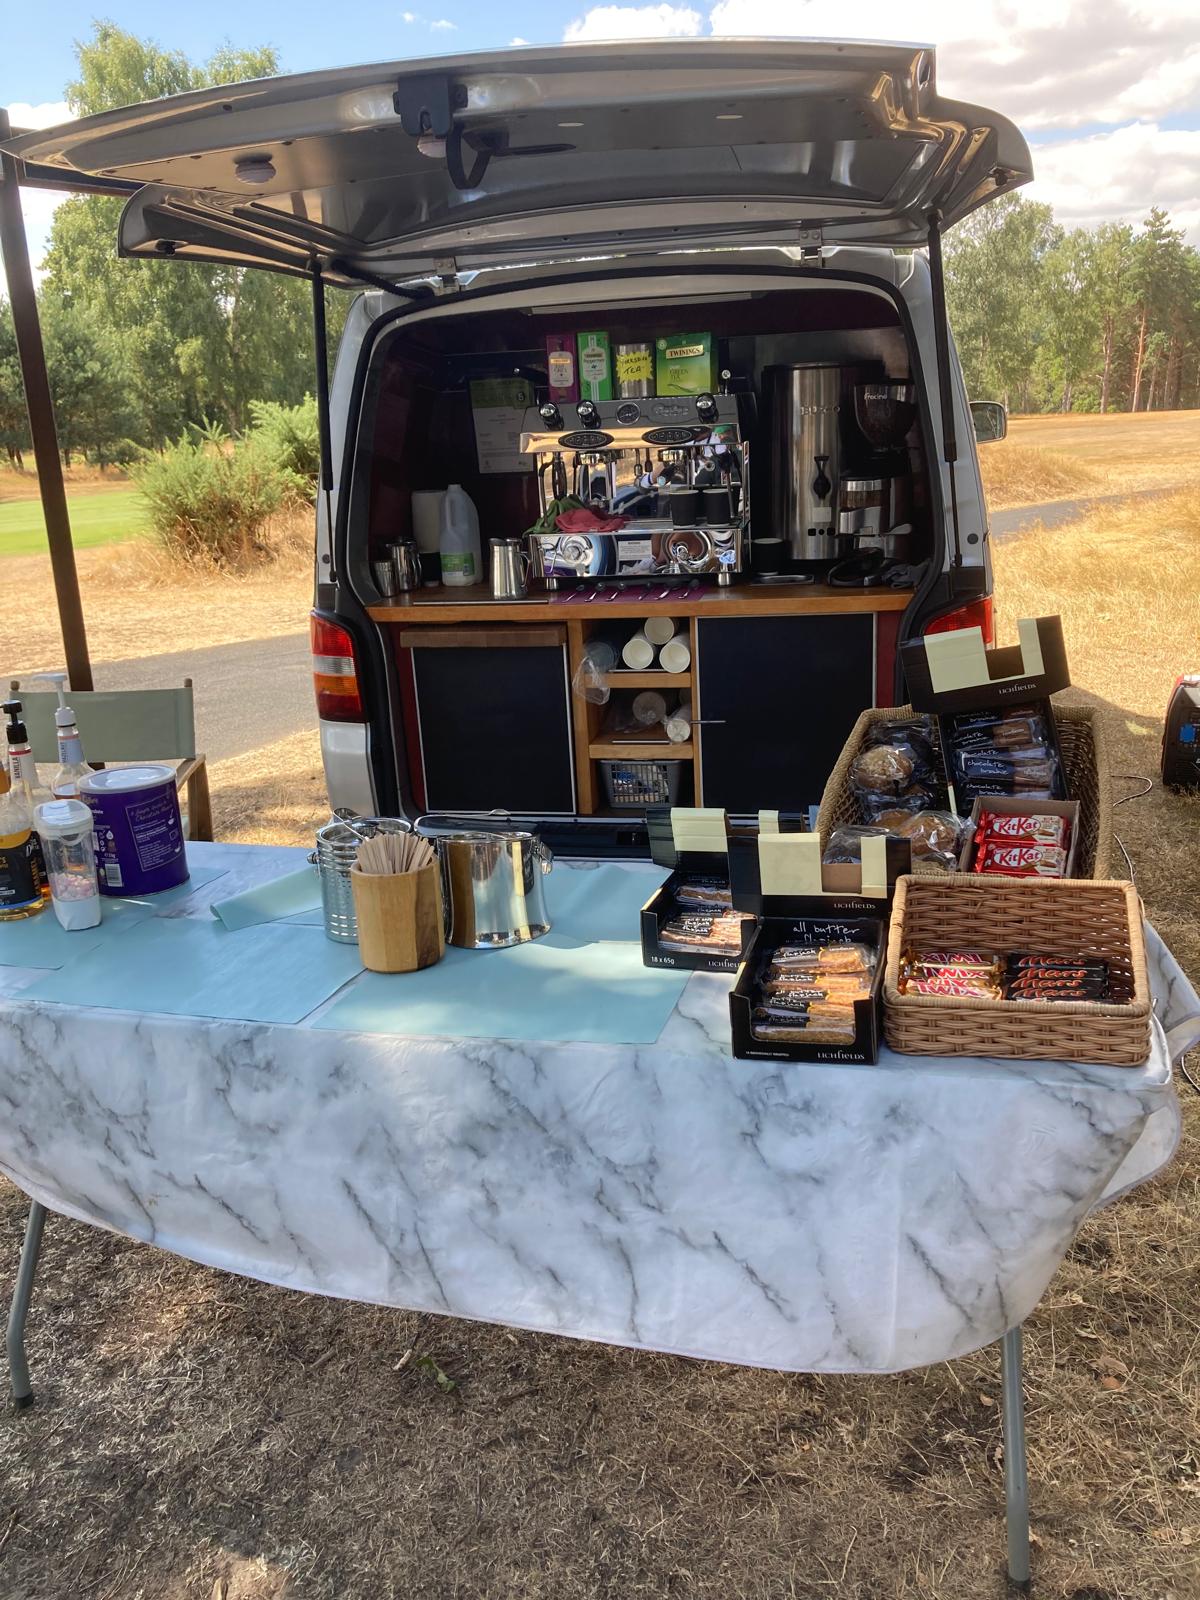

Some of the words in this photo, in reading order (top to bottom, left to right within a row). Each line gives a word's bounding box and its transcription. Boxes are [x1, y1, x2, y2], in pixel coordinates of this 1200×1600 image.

[669, 347, 701, 357] TWININGS
[624, 366, 641, 374] TEA
[967, 759, 1005, 768] chocolate
[980, 767, 1009, 775] brownie
[998, 818, 1038, 835] KitKat
[999, 848, 1039, 866] KitKat
[793, 921, 807, 933] all
[814, 924, 861, 934] butter
[1018, 955, 1088, 967] Mars
[923, 968, 988, 978] TWIX
[1017, 967, 1088, 978] Mars
[1010, 977, 1084, 988] Mars
[916, 982, 983, 998] TWIX
[1011, 988, 1087, 997] Mars
